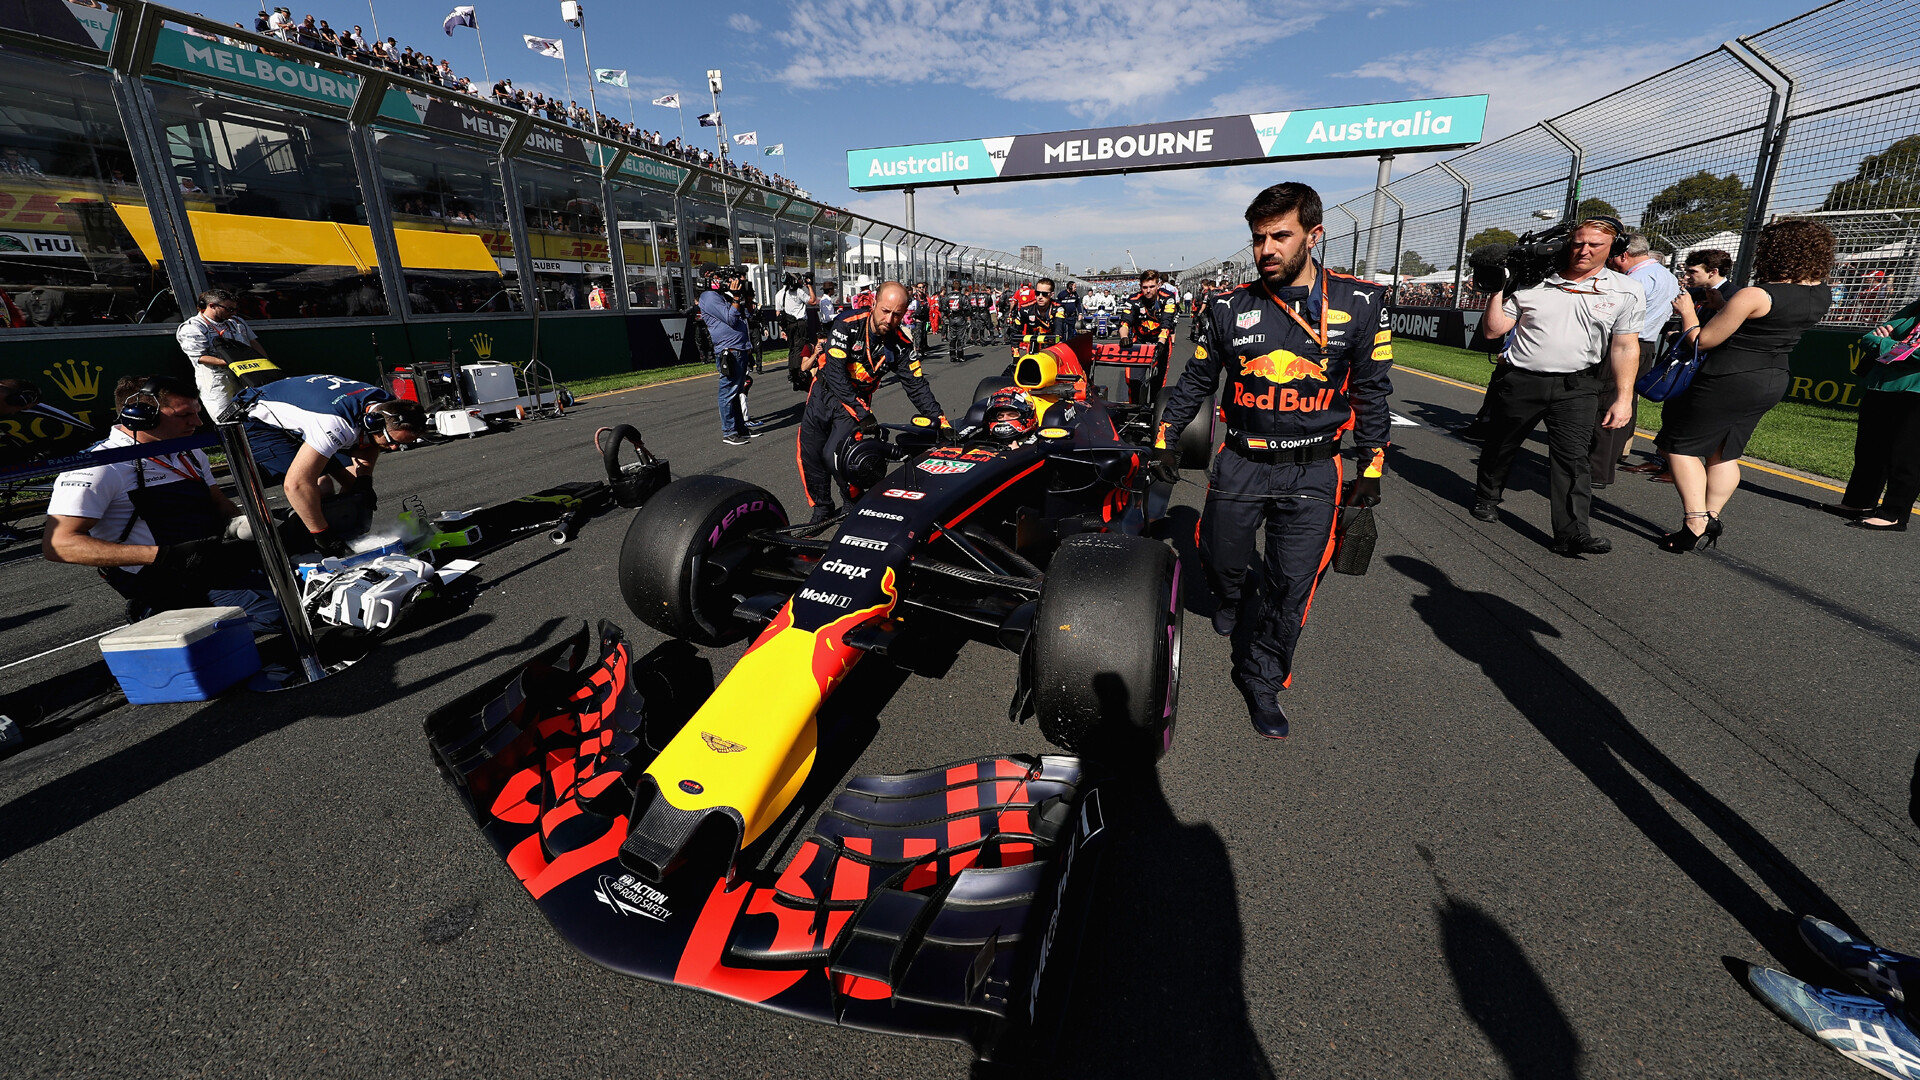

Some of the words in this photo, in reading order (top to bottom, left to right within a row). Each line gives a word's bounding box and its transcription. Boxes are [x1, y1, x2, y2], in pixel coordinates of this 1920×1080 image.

[77, 17, 108, 31] MEL
[182, 40, 359, 100] MELBOURN
[1256, 126, 1280, 138] MEL
[1305, 112, 1452, 144] Australia
[1044, 129, 1213, 164] MELBOURNE
[988, 149, 1008, 160] MEL
[868, 151, 968, 178] Australia
[533, 260, 561, 270] AUBER
[1464, 324, 1477, 334] MEL
[668, 333, 685, 342] MEL
[1232, 335, 1254, 347] Mobil
[1099, 344, 1157, 363] Bull
[238, 359, 259, 372] REAR
[1234, 382, 1275, 410] Red
[1279, 388, 1335, 412] Bull
[1270, 440, 1279, 449] O.
[47, 451, 93, 468] RACING
[929, 451, 960, 461] Red
[961, 453, 991, 461] Bull
[924, 459, 973, 470] TAG
[884, 490, 926, 499] 33
[858, 508, 904, 522] Hisense
[709, 501, 763, 548] ZERO
[840, 535, 888, 551] PIRELLI
[799, 588, 838, 607] Mobil
[619, 874, 634, 885] FIA
[631, 881, 668, 904] ACTION
[611, 881, 623, 894] FOR
[621, 886, 647, 906] ROAD
[640, 898, 673, 919] SAFETY
